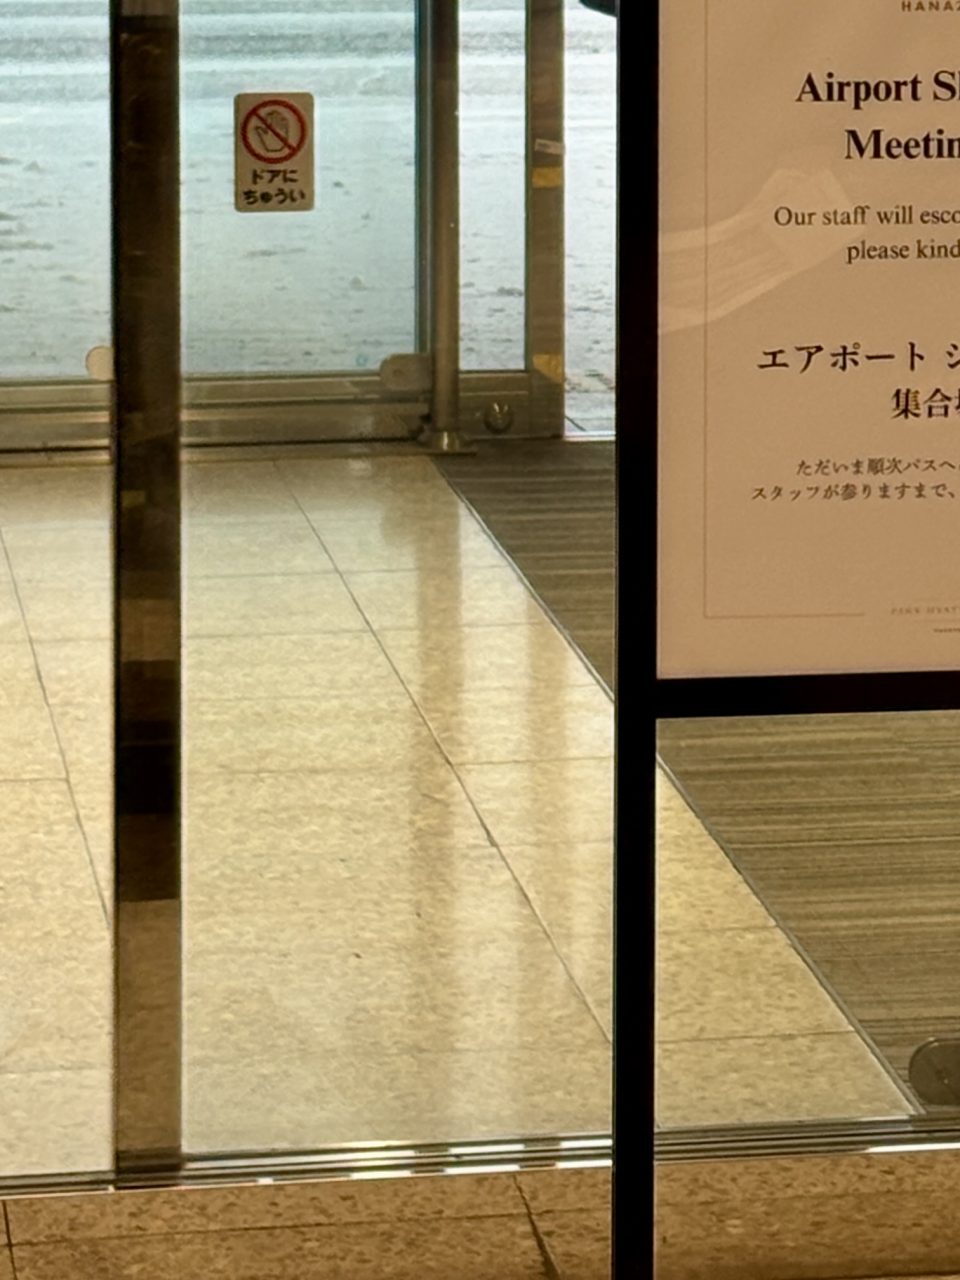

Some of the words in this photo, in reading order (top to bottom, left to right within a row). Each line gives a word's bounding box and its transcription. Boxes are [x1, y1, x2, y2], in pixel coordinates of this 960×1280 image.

[795, 71, 922, 110] Airport
[252, 169, 299, 185] ドアに
[243, 189, 306, 205] ちゅうい
[774, 206, 817, 226] Our
[822, 205, 870, 225] staff
[876, 205, 914, 224] will
[846, 240, 910, 264] please
[757, 342, 925, 374] エアポート
